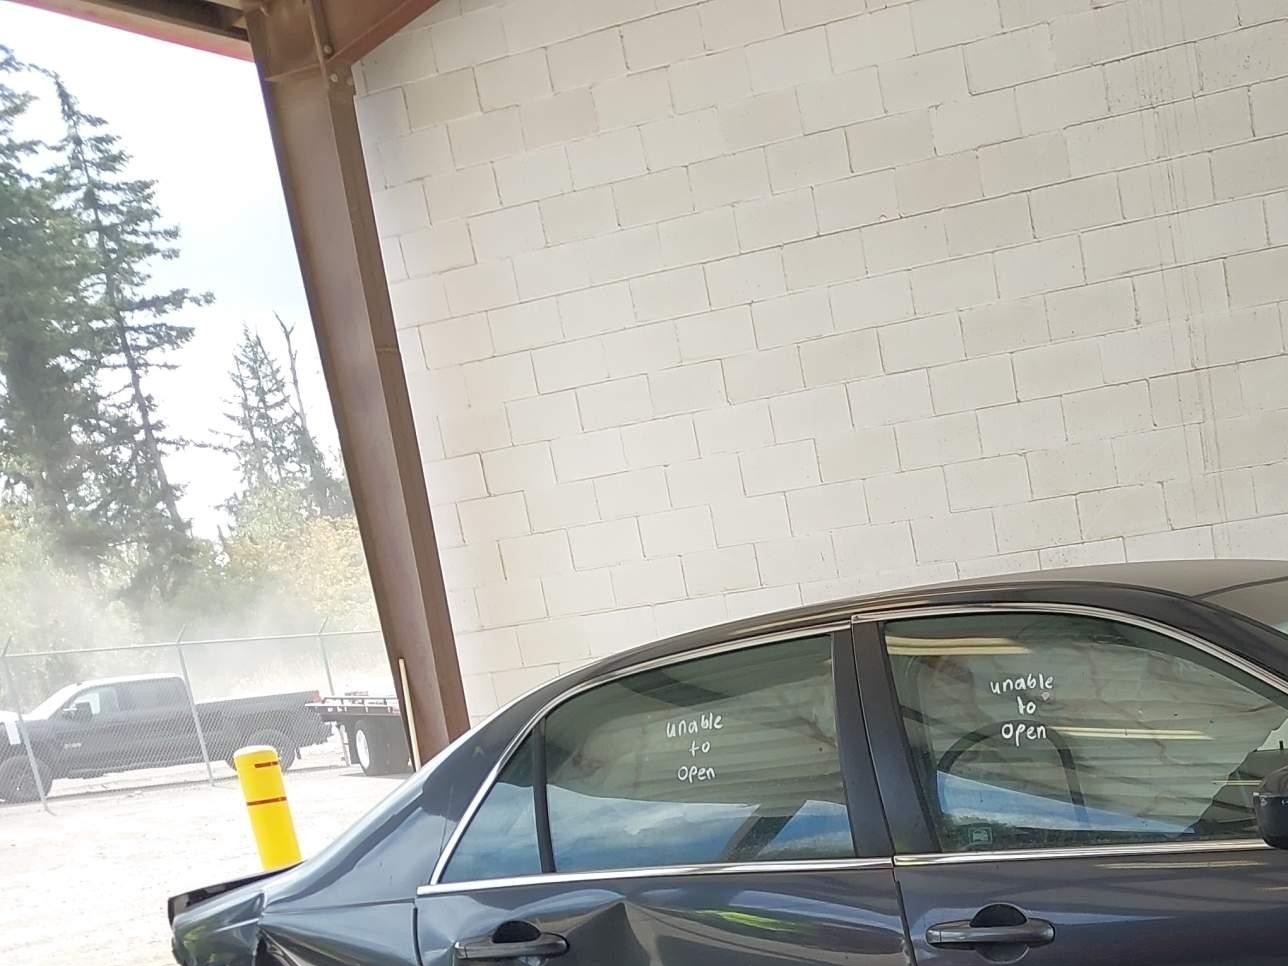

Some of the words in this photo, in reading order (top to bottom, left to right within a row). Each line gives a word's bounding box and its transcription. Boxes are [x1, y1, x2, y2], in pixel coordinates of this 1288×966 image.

[990, 673, 1054, 694] unable
[1017, 696, 1036, 715] to
[666, 711, 723, 738] unable
[689, 740, 711, 757] to
